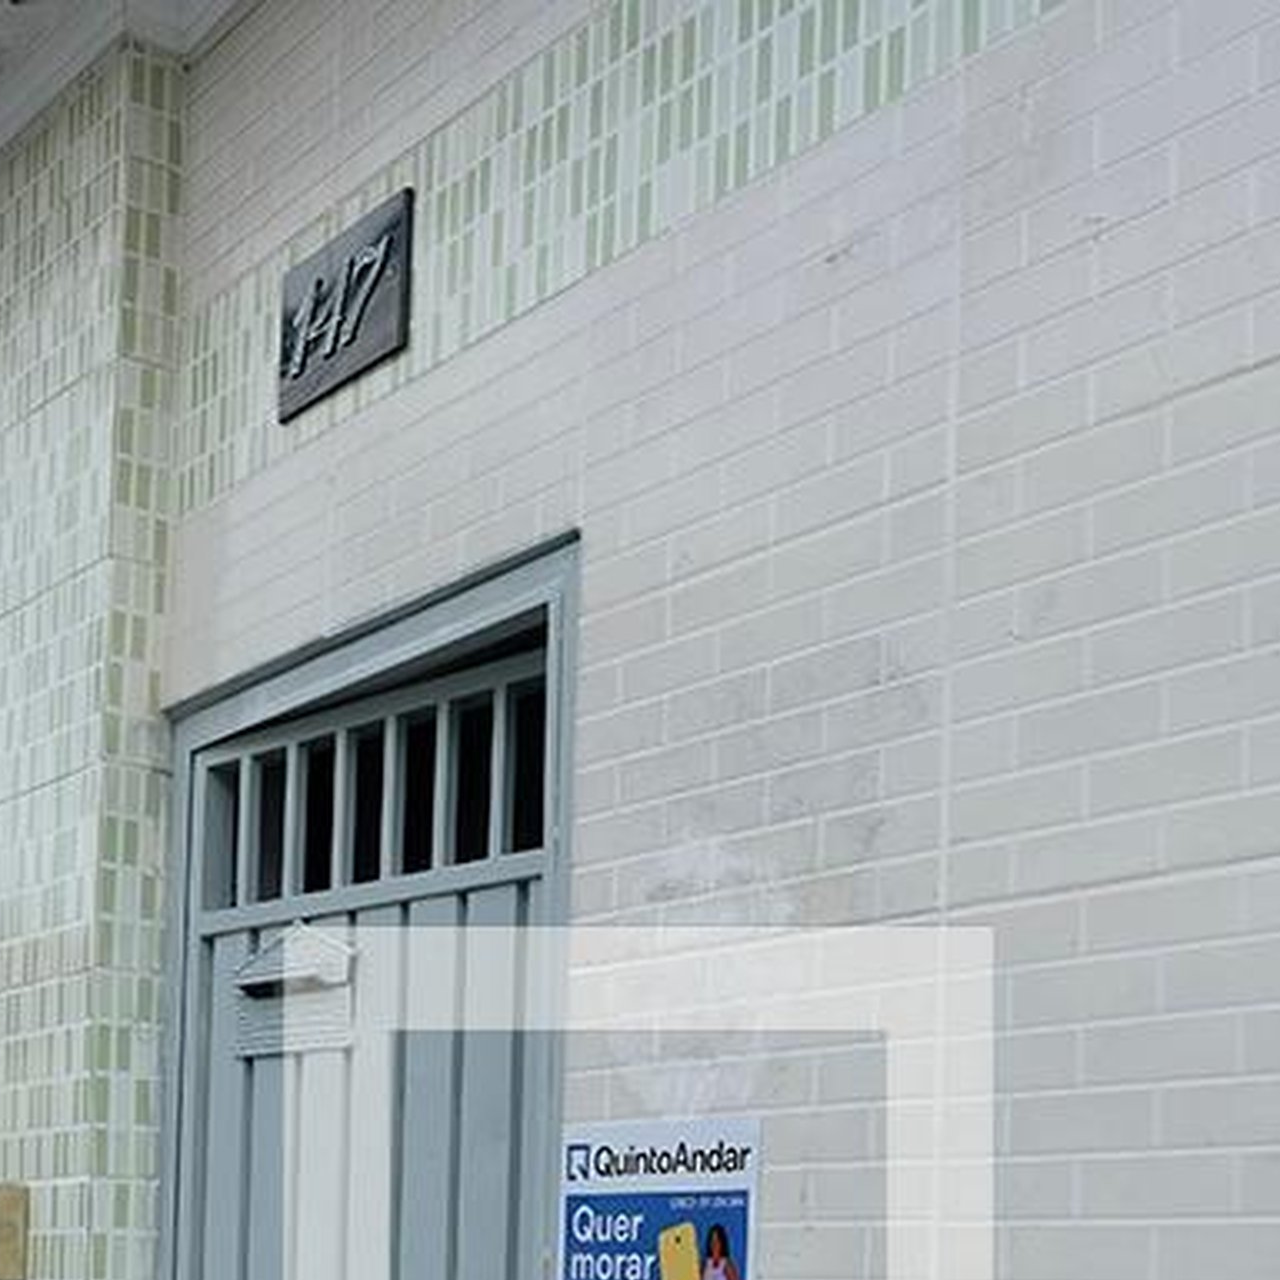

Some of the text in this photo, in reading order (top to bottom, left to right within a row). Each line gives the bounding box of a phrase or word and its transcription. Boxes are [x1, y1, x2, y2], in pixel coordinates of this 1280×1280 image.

[594, 1141, 751, 1177] QuintoAndar
[572, 1205, 644, 1242] Quer
[571, 1253, 656, 1280] morar
